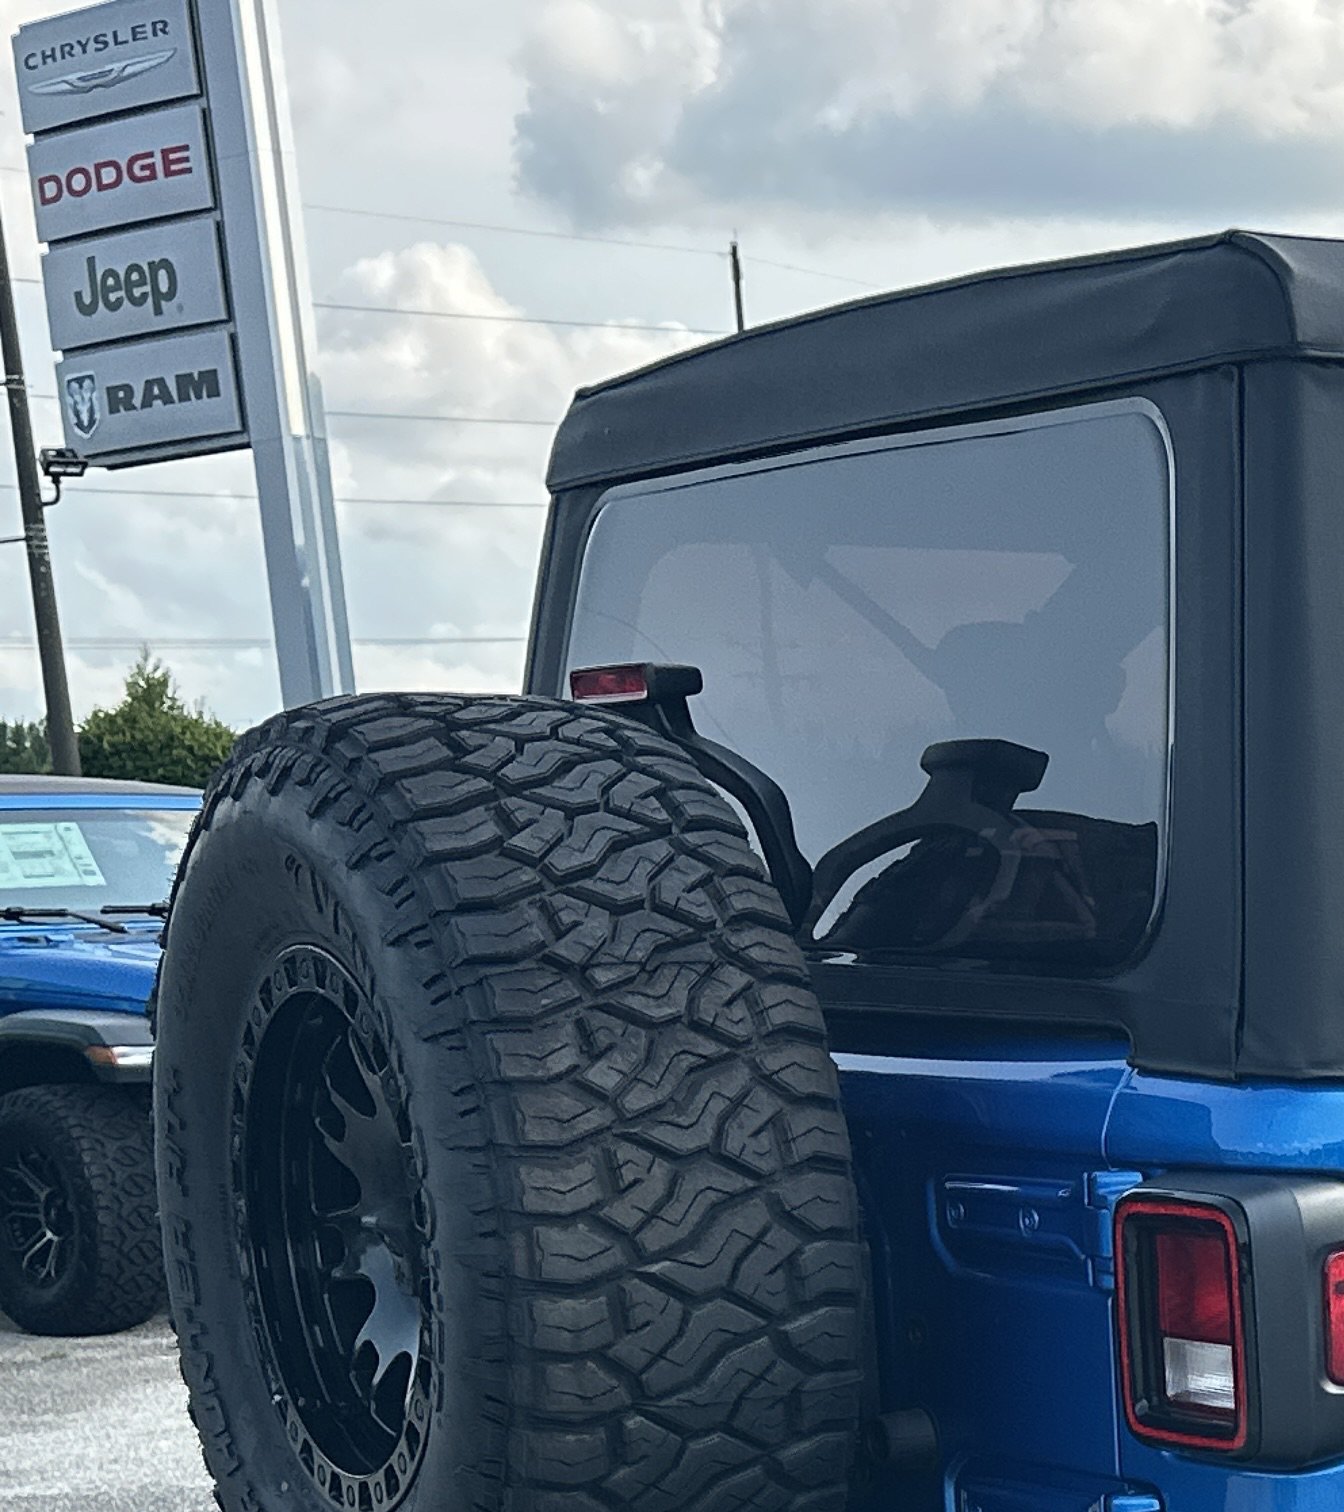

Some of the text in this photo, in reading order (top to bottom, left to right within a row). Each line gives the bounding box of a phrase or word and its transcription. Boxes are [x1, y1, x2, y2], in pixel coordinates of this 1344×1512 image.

[24, 19, 170, 72] CHRYSLER
[38, 144, 193, 205] DODGE
[73, 255, 178, 316] Jeep
[106, 368, 221, 415] RAM
